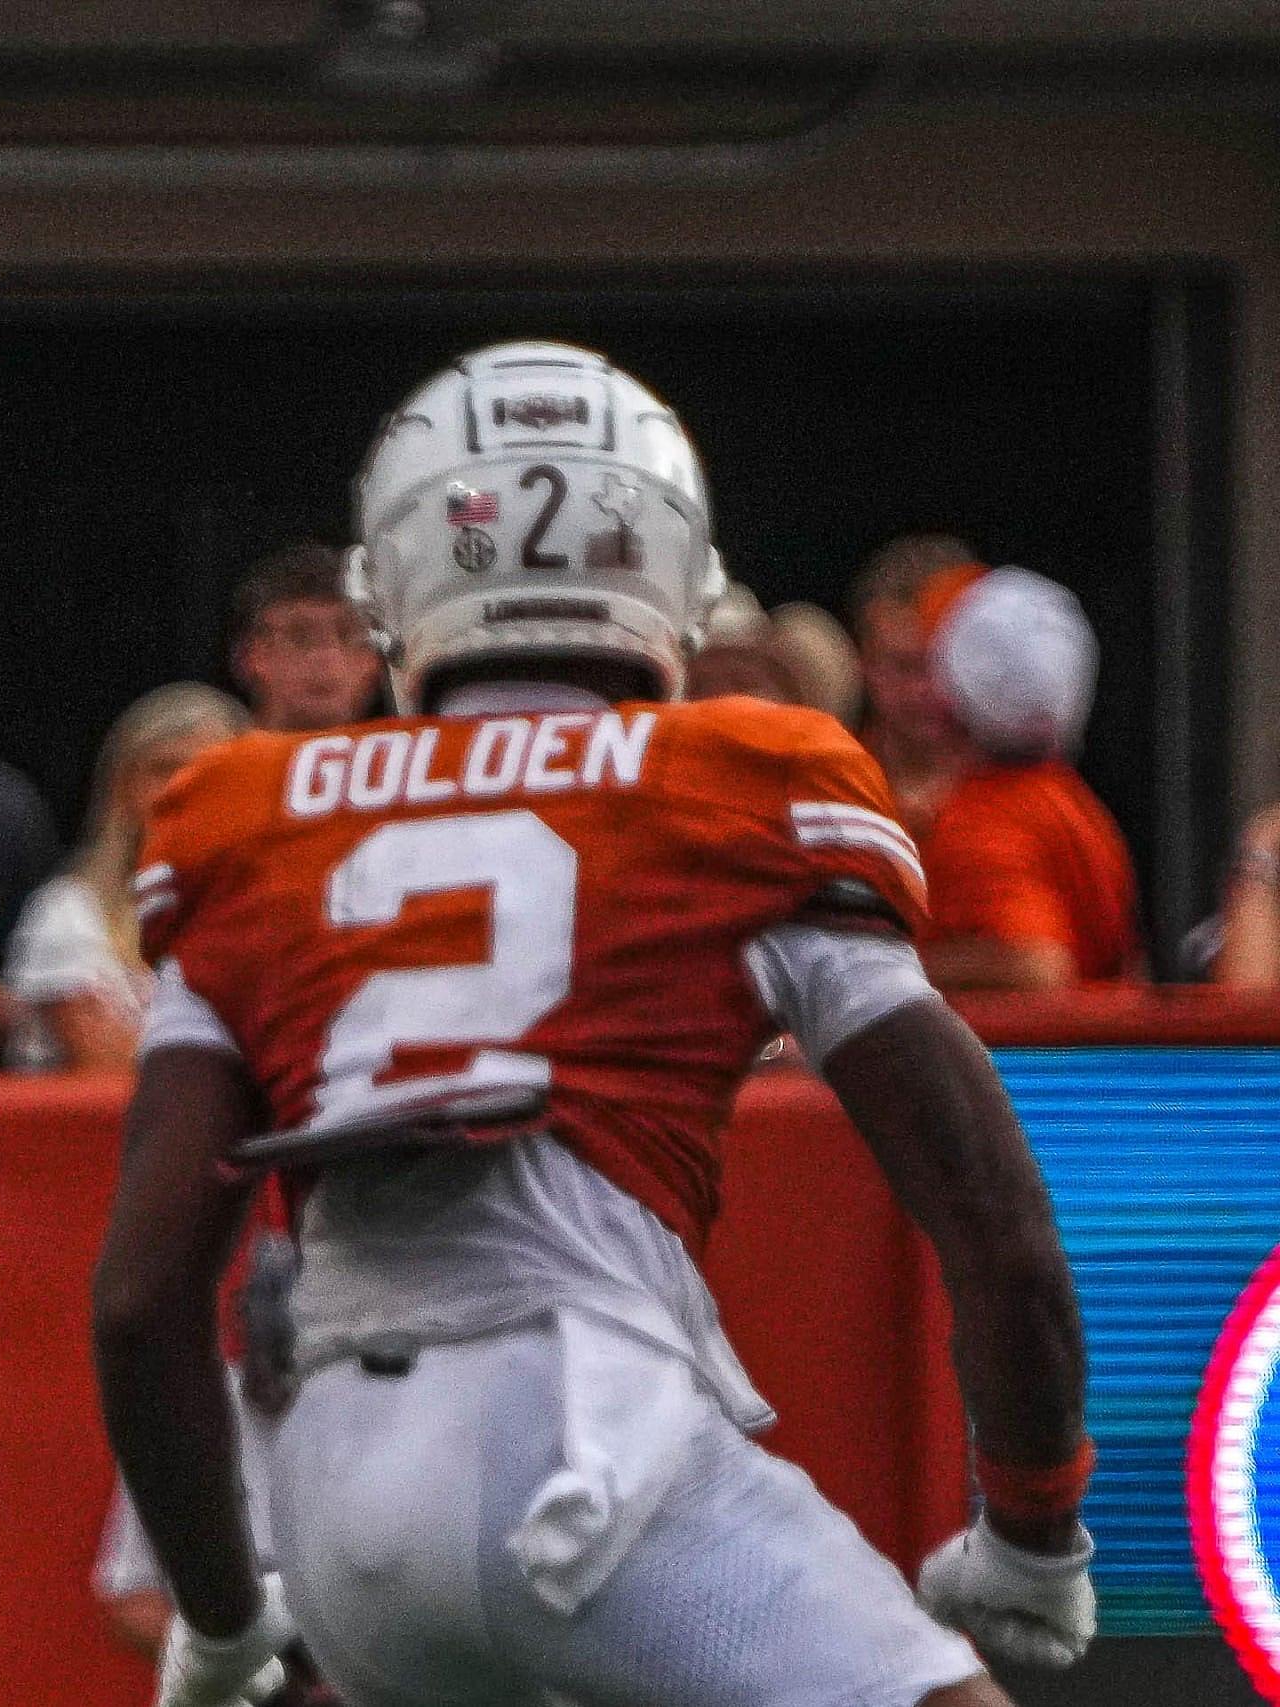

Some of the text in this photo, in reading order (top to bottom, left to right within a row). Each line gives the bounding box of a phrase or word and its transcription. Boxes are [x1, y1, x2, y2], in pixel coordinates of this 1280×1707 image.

[519, 464, 569, 569] 2
[286, 713, 657, 817] GOLDEN
[308, 810, 578, 1129] 2
